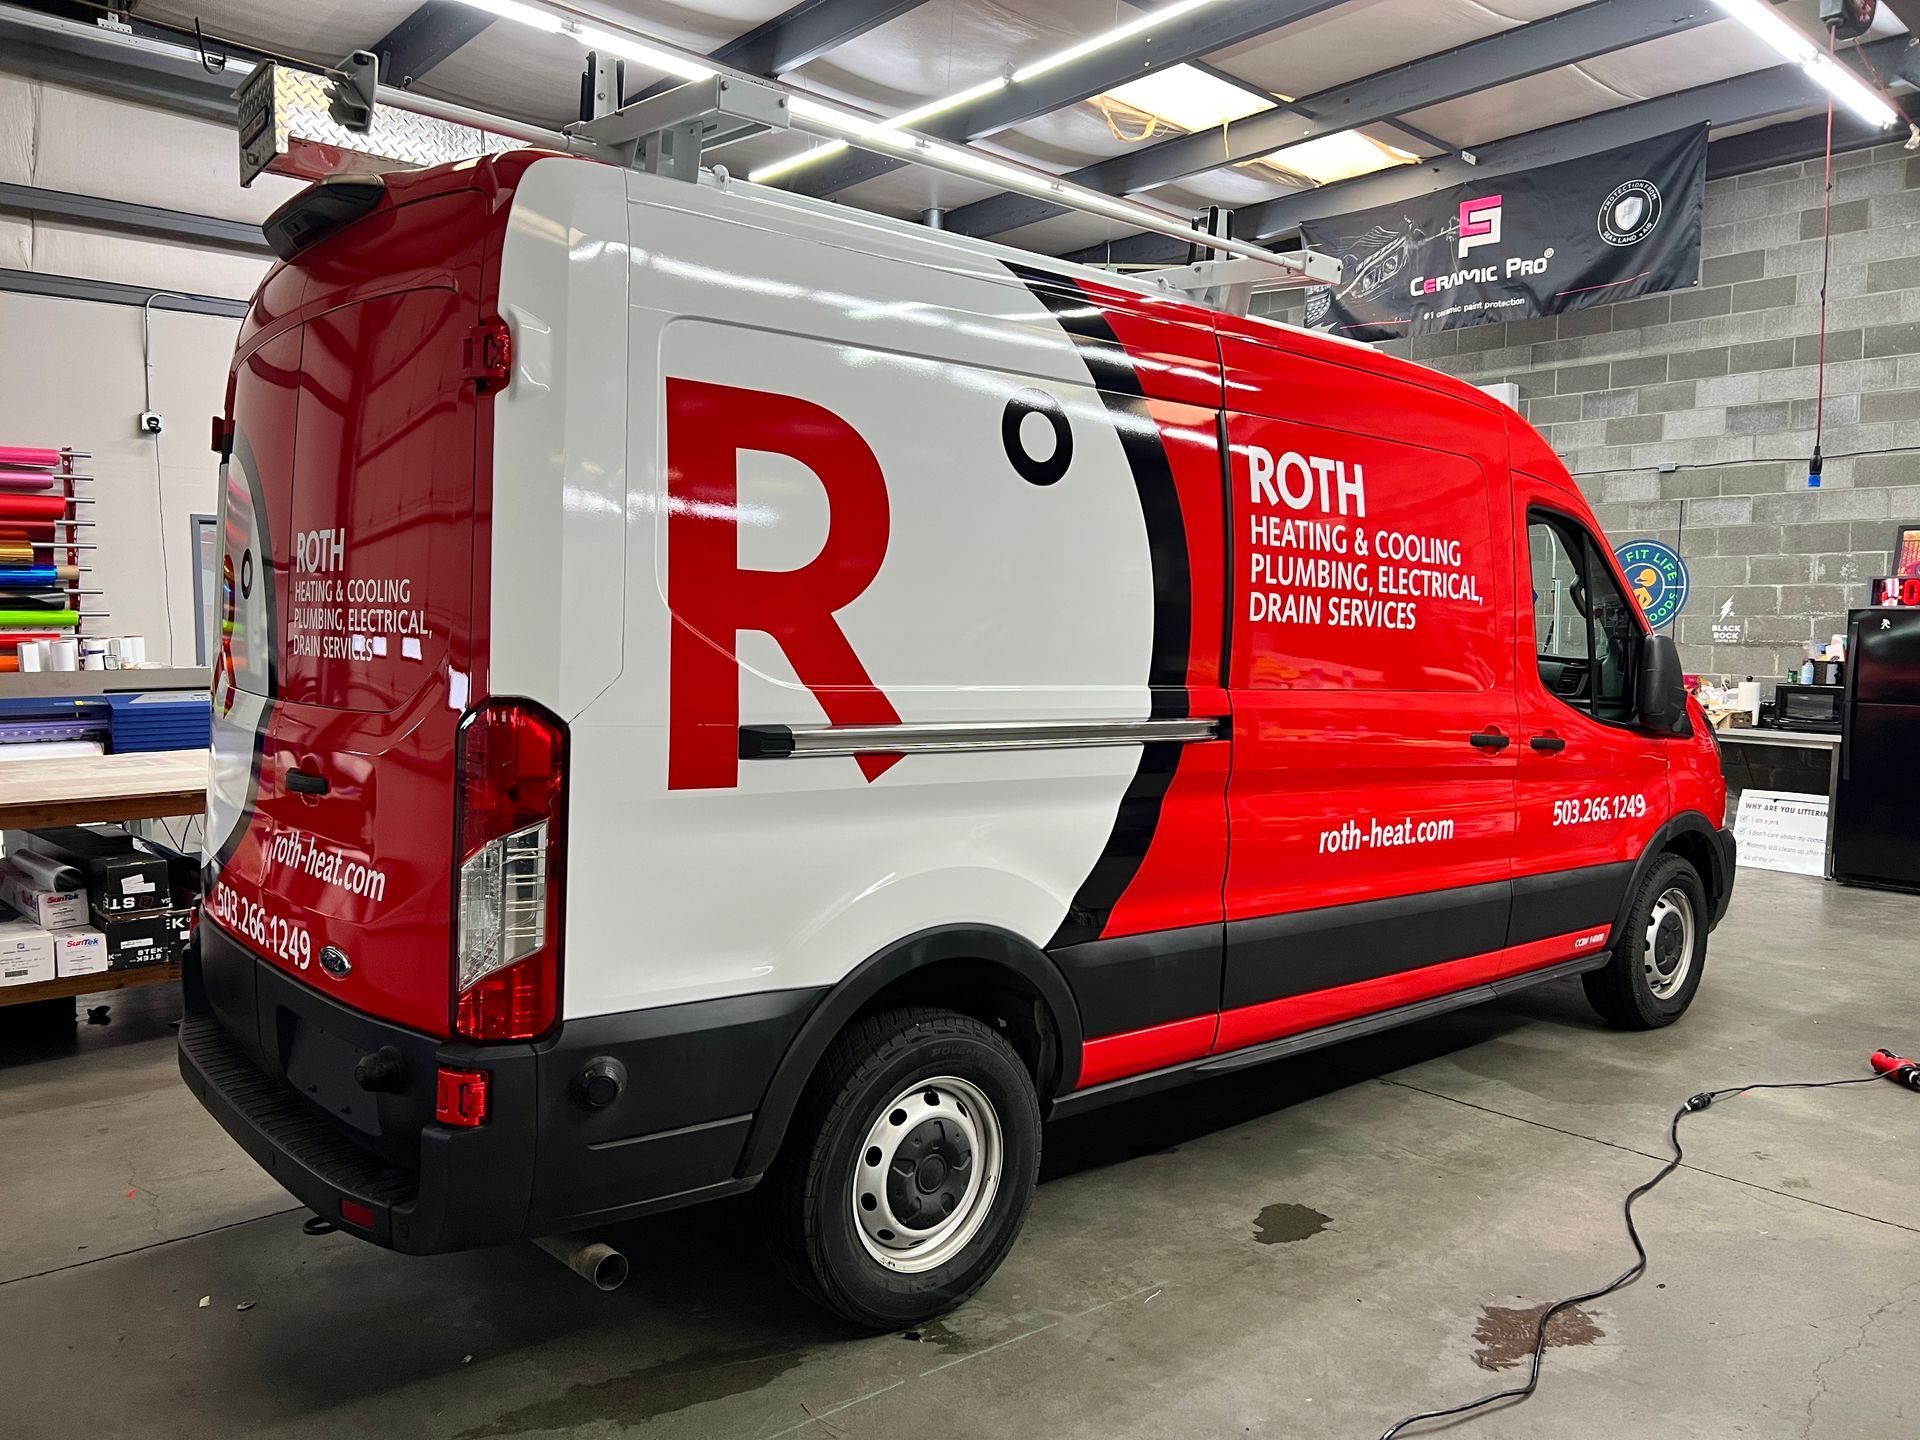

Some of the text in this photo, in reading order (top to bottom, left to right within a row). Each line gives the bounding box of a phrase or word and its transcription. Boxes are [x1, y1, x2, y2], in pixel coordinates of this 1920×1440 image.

[1617, 234, 1637, 243] LAND
[1642, 222, 1653, 234] AIR
[1436, 305, 1462, 318] ceramic
[1463, 300, 1483, 313] paint
[1484, 297, 1525, 311] protection
[1248, 445, 1366, 518] ROTH
[296, 528, 345, 574] ROTH
[1250, 514, 1462, 567] HEATING & COOLING
[1250, 552, 1484, 606] PLUMBING, ELECTRICAL,
[1625, 549, 1677, 581] FIT LIFE
[294, 579, 411, 603] HEATING & COOLING
[1648, 592, 1677, 622] OODS
[293, 608, 433, 640] PLUMBING, ELECTRICAL,
[1249, 591, 1417, 630] DRAIN SERVICES
[1711, 624, 1741, 632] BLACK
[293, 635, 373, 662] DRAIN SERVICES
[1552, 793, 1647, 826] 503.266.1249
[1745, 802, 1828, 818] WHY ARE YOU LITTERIN
[1319, 817, 1454, 853] roth-heat.com
[272, 832, 386, 902] roth-heat.com
[47, 893, 79, 904] SunTek
[217, 881, 311, 971] 503.266.1249
[66, 938, 99, 948] SunTek
